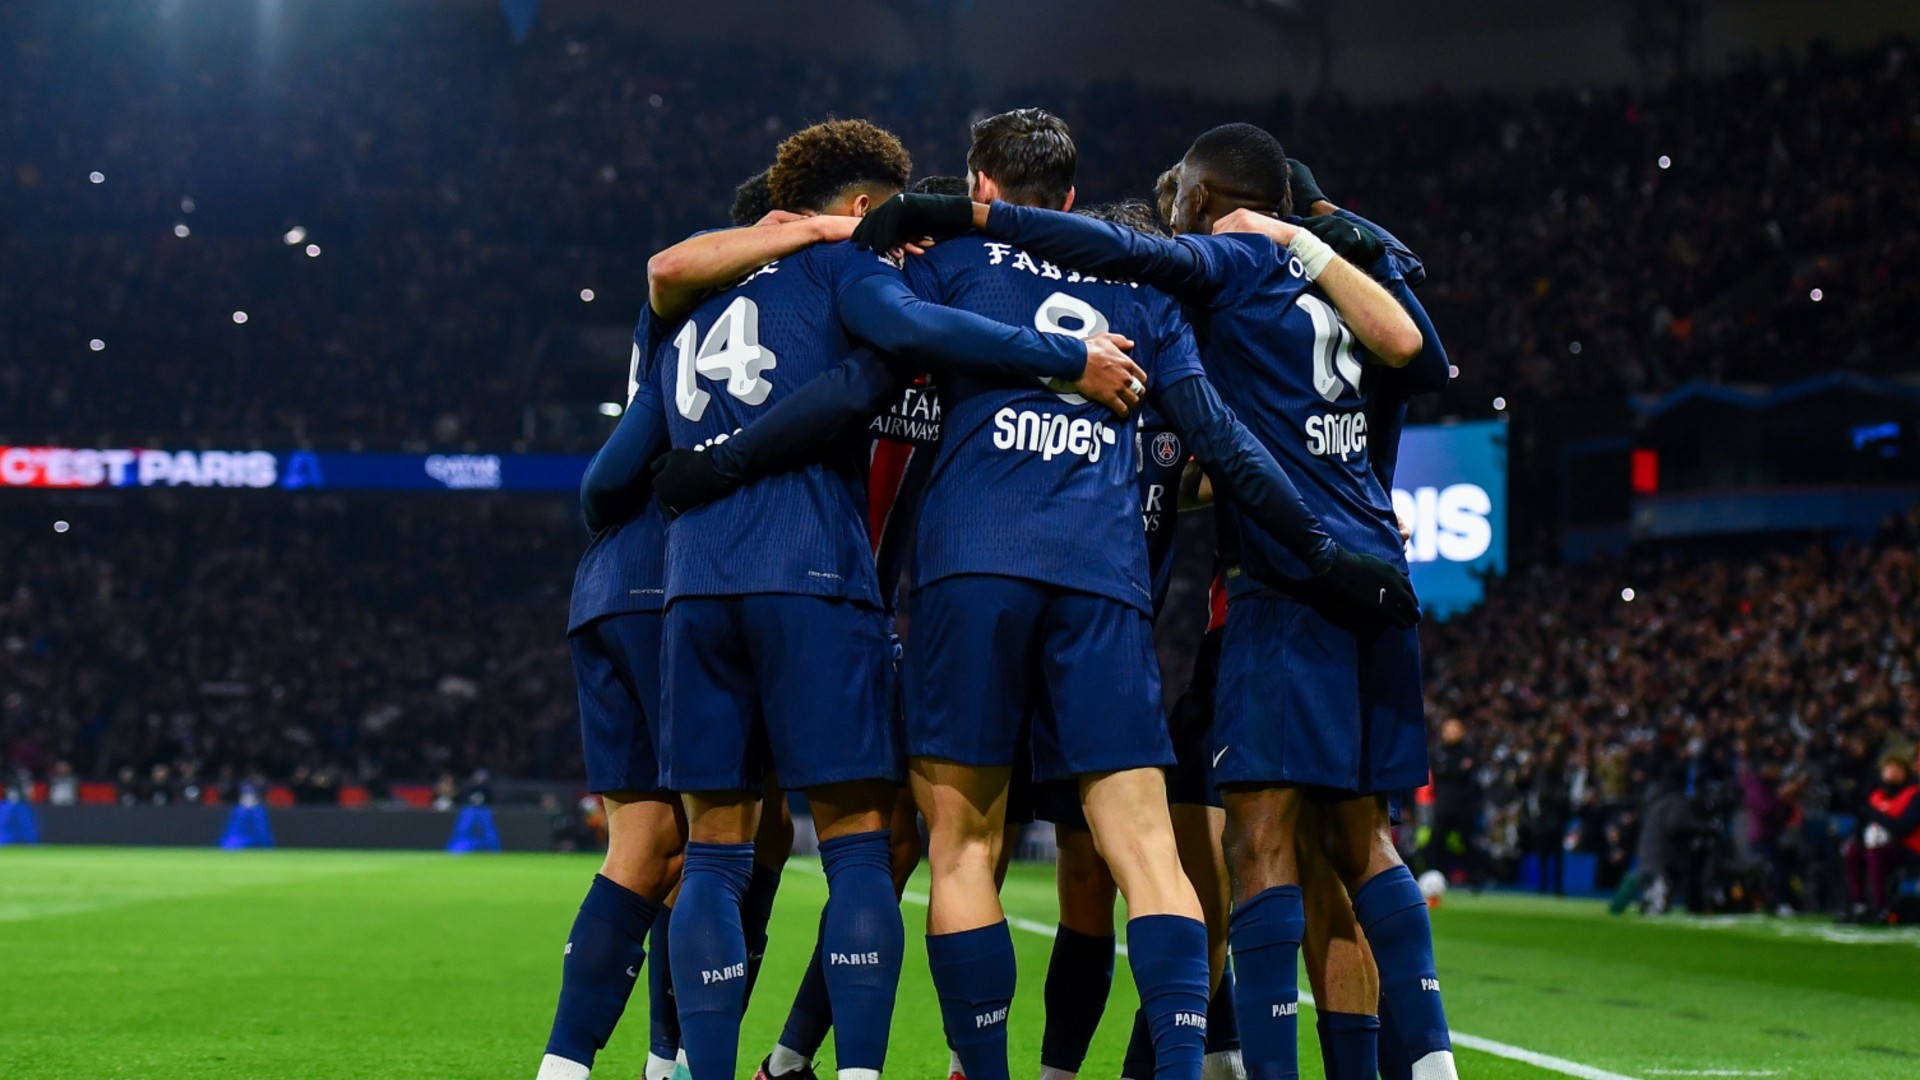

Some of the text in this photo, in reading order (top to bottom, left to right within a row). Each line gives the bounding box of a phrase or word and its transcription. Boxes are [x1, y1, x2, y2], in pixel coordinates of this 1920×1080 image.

[673, 295, 777, 422] 14
[891, 388, 941, 421] TAR
[868, 415, 940, 441] AIRWAYS
[1305, 411, 1368, 462] snipe
[138, 450, 278, 488] PARIS
[1391, 483, 1492, 562] RIS
[831, 951, 879, 965] PARIS
[701, 962, 745, 984] PARIS
[975, 1006, 1008, 1028] PARIS
[1175, 1013, 1208, 1030] PARIS
